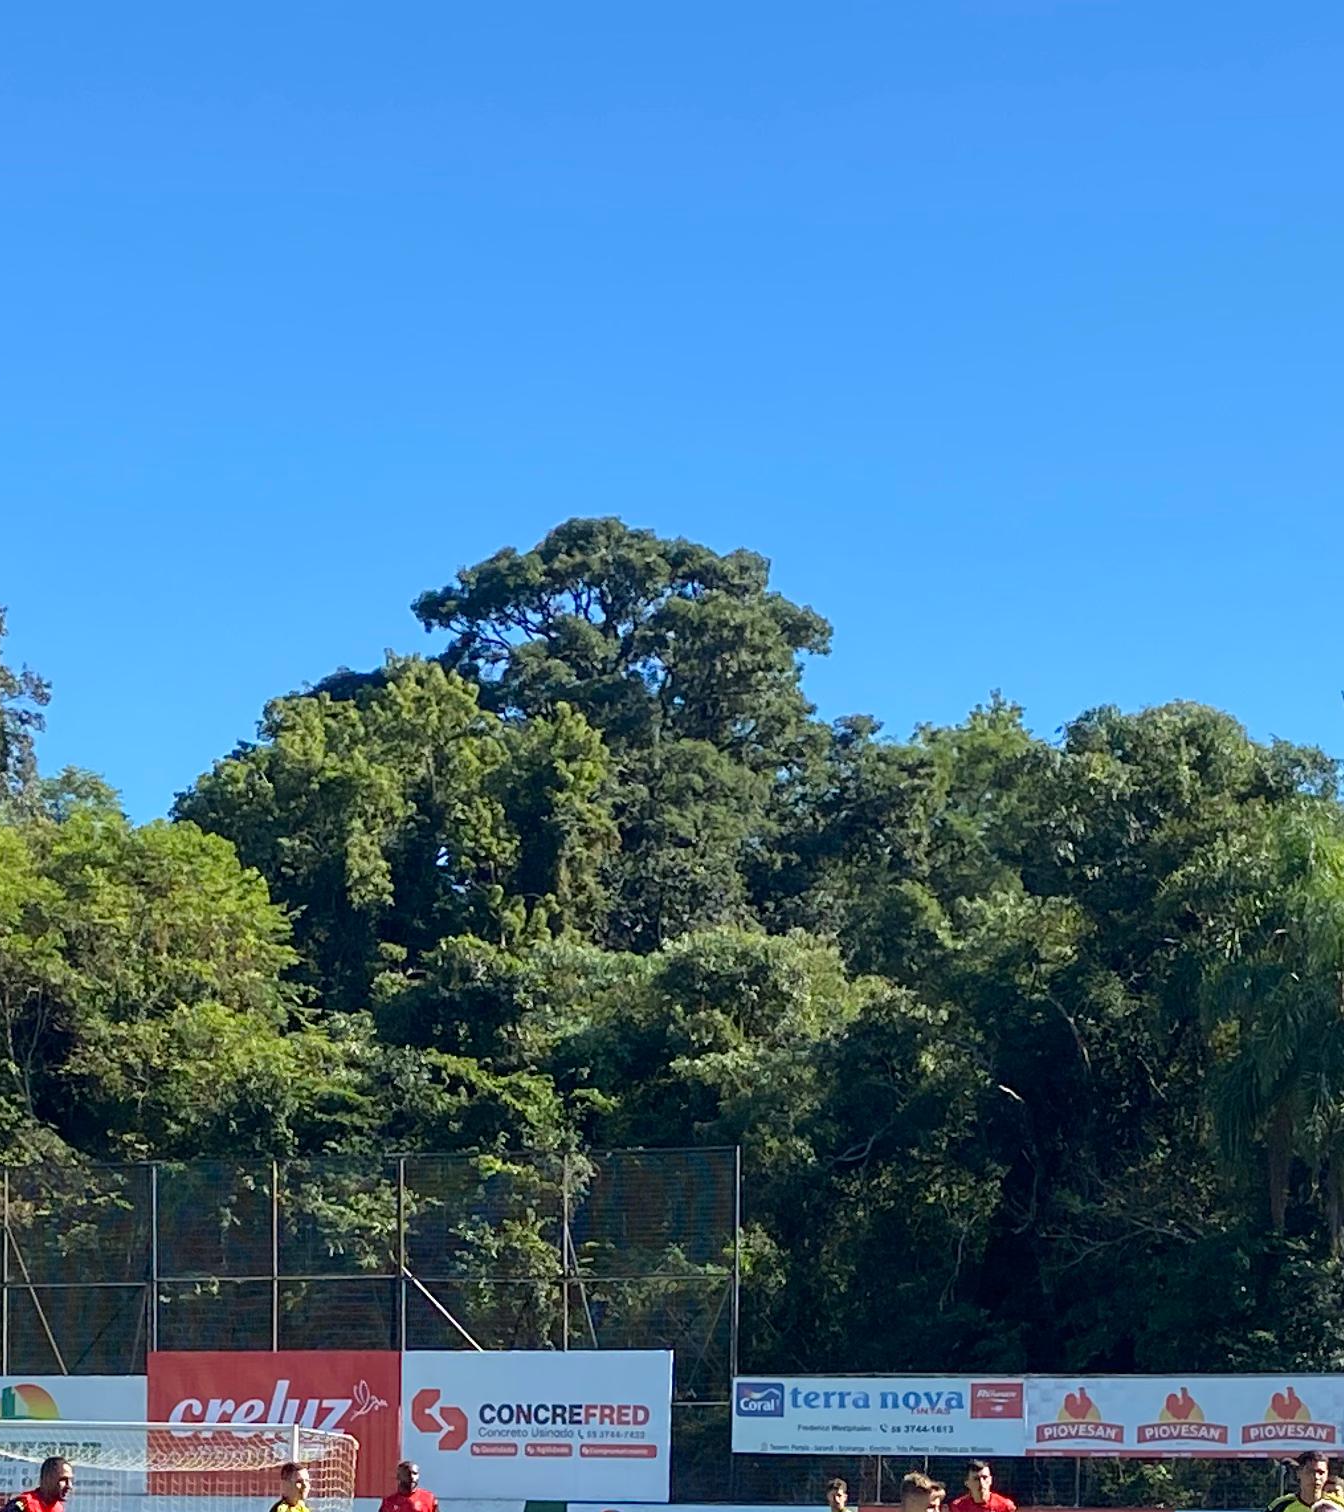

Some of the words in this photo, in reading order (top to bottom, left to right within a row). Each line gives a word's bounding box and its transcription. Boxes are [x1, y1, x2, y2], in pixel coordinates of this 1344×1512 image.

[739, 1396, 776, 1412] Coral
[789, 1387, 873, 1410] terra
[879, 1391, 965, 1411] nova
[169, 1380, 353, 1438] creluz
[479, 1403, 650, 1426] CONCREFRED
[478, 1427, 528, 1438] Concreto
[532, 1427, 573, 1439] Usinado
[1044, 1424, 1119, 1440] PIOVESAN
[1145, 1424, 1222, 1440] PIOVESAN
[1250, 1424, 1329, 1440] PIOVESAN
